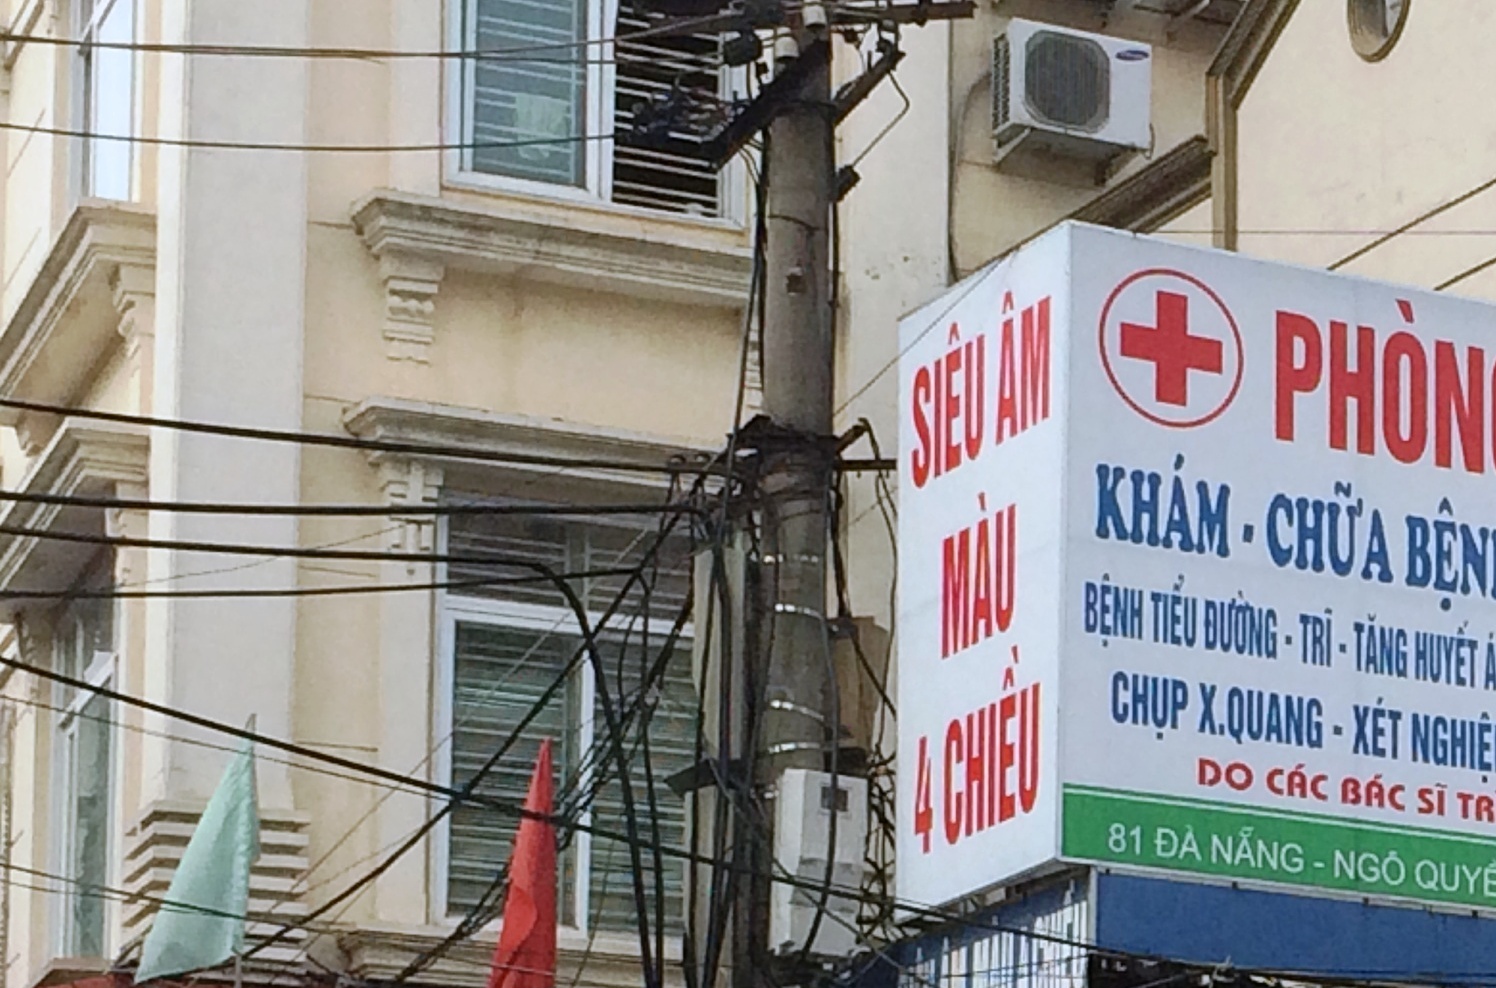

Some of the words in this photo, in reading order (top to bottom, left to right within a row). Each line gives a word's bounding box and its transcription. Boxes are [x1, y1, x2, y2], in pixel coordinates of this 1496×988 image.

[911, 322, 985, 488] SIÊU
[996, 292, 1051, 446] ÂM
[941, 492, 1018, 660] MÀU
[1095, 452, 1231, 558] KHÁM
[1266, 480, 1394, 585] CHỮA
[1084, 573, 1144, 648] BỆNH
[1151, 574, 1198, 648] TIỂU
[1203, 589, 1278, 660] ĐƯỜNG
[1299, 608, 1333, 668] TRĨ
[1353, 612, 1408, 679] TĂNG
[1414, 620, 1479, 689] HUYẾT
[914, 736, 934, 855] 4
[943, 645, 1041, 846] CHIỀU
[1110, 670, 1189, 741] CHỤP
[1197, 680, 1325, 750] X.QUANG
[1352, 697, 1403, 760] XÉT
[1197, 757, 1255, 792] DO
[1265, 763, 1330, 802] CÁC
[1340, 773, 1407, 812] BÁC
[1417, 782, 1448, 817] SĨ
[1108, 822, 1142, 857] 81
[1153, 824, 1203, 862] ĐÀ
[1210, 825, 1305, 874] NẴNG
[1333, 848, 1406, 886] NGÔ
